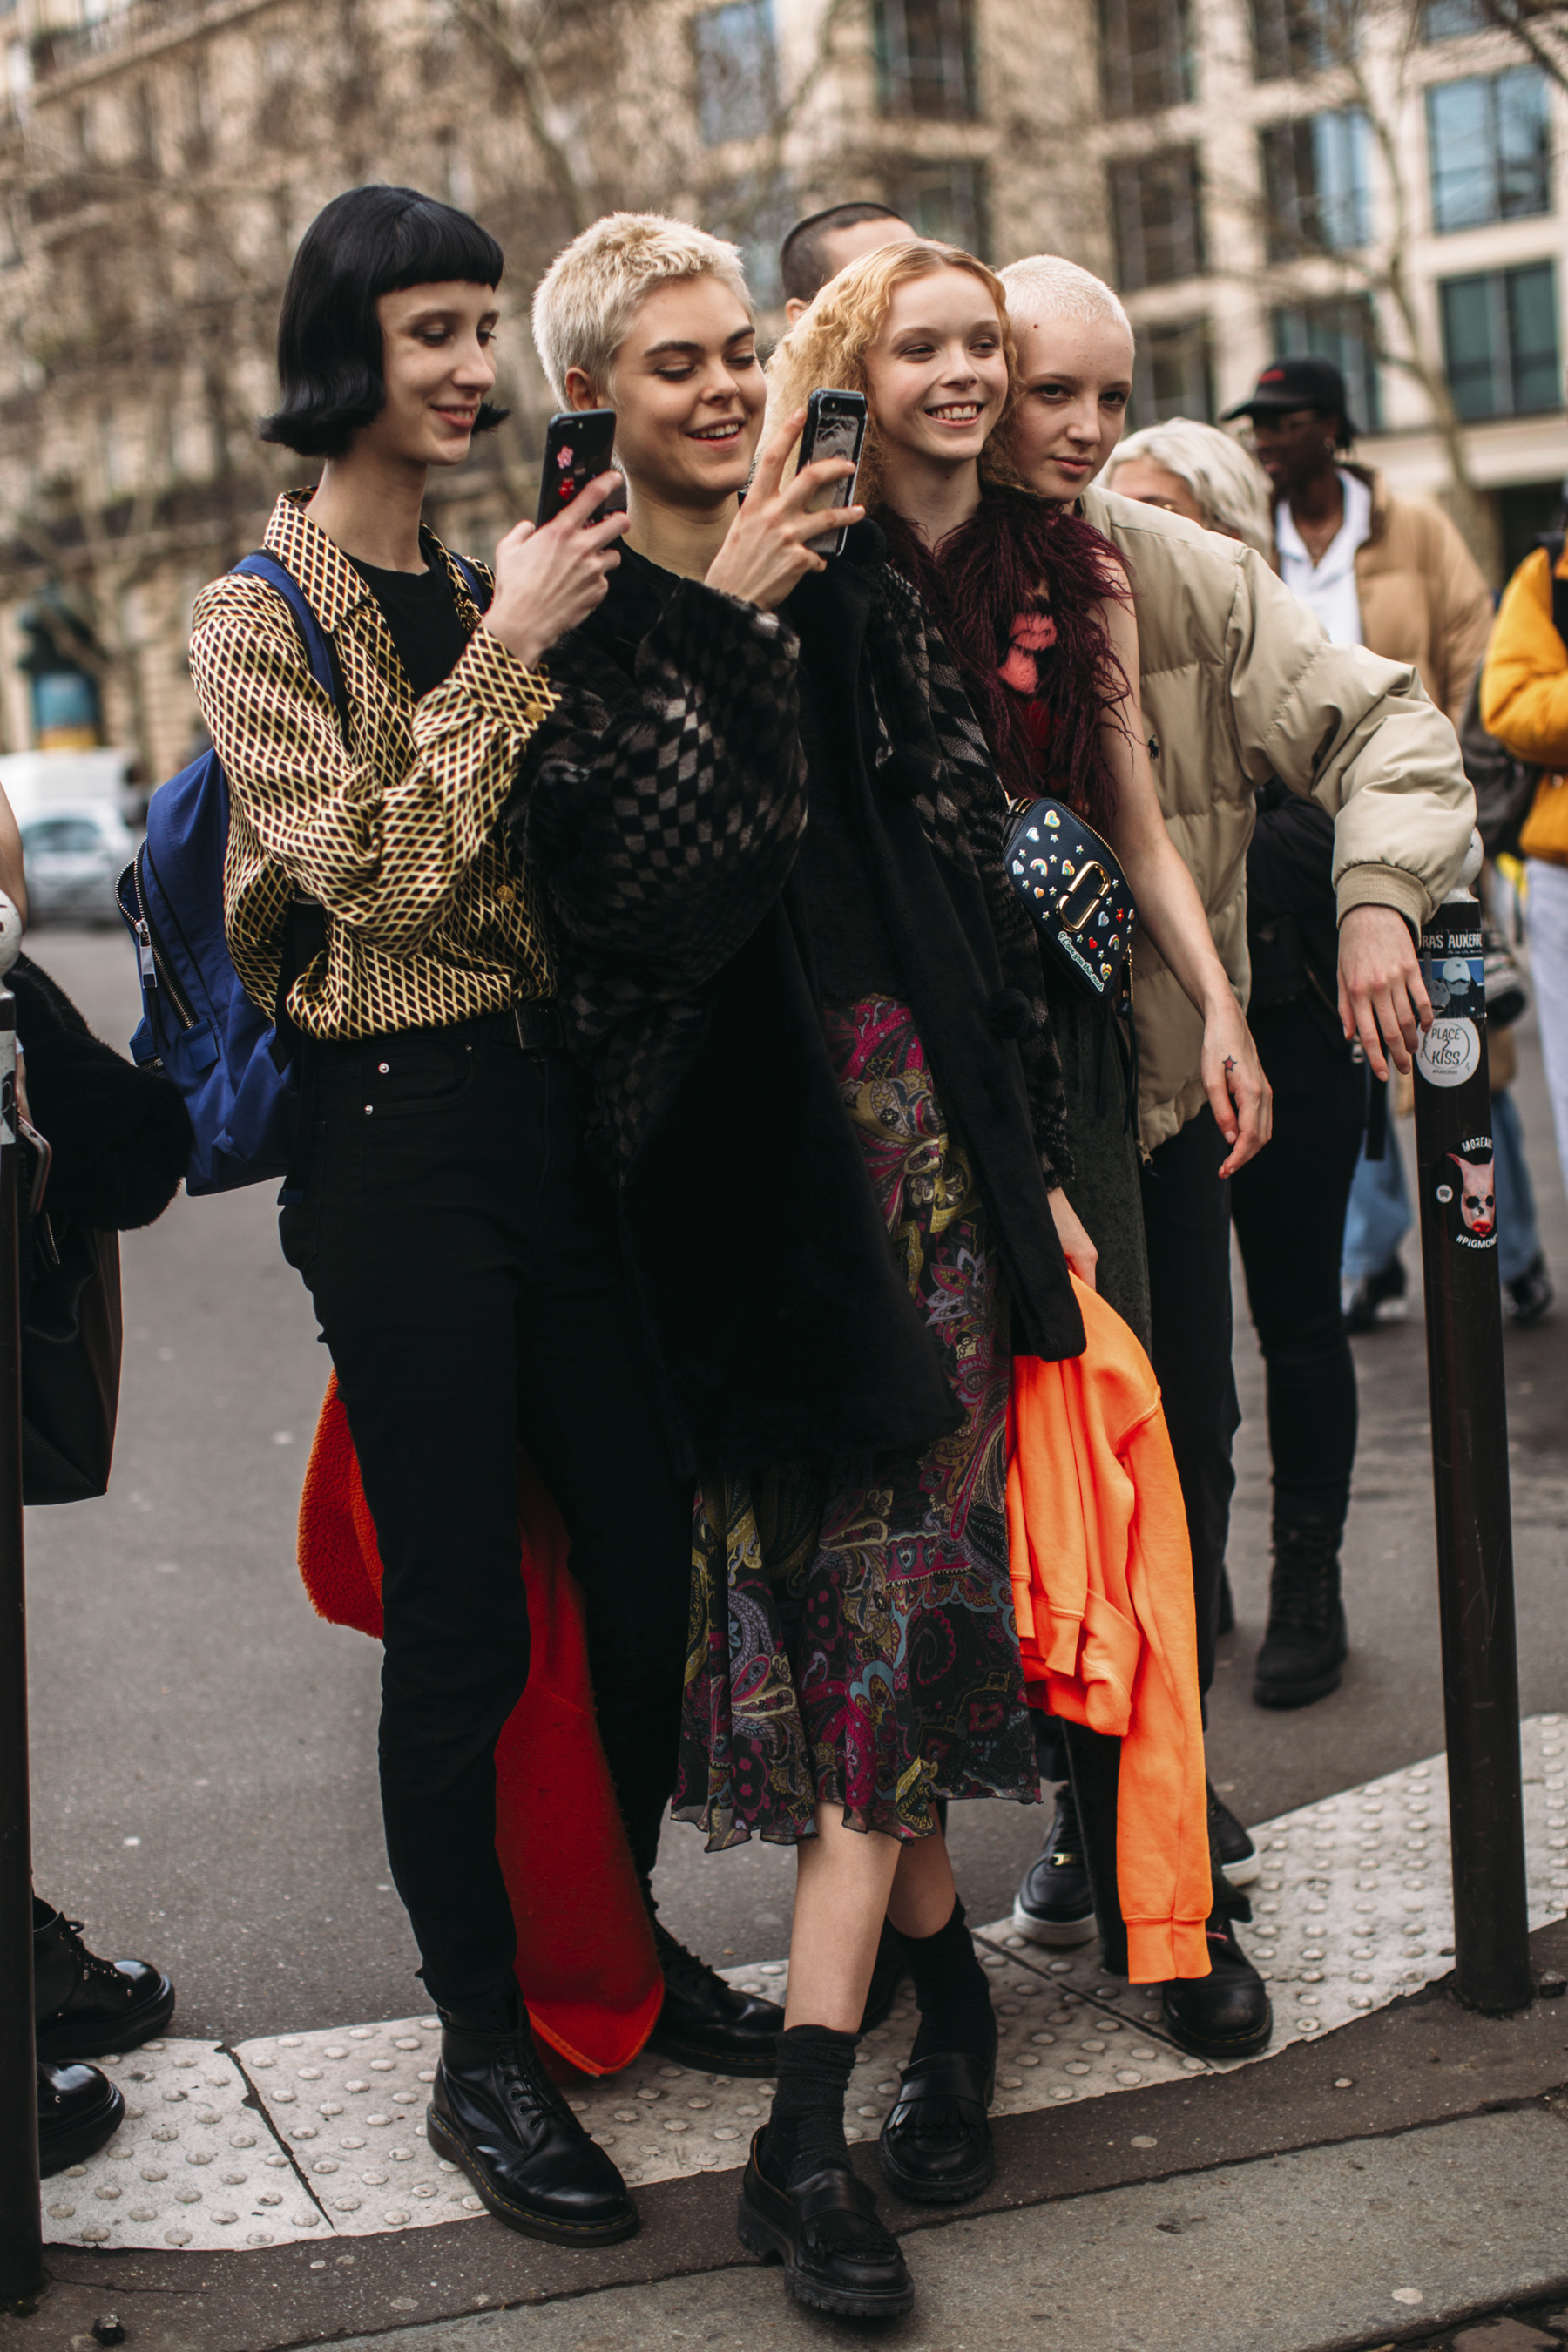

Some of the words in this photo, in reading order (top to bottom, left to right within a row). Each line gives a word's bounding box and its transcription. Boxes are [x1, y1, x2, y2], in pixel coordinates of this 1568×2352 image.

[1422, 934, 1444, 949] RAS
[1072, 953, 1084, 965] you
[1082, 963, 1092, 976] this
[1091, 975, 1104, 990] much
[1431, 1028, 1461, 1039] PLACE
[1432, 1051, 1461, 1064] KISS
